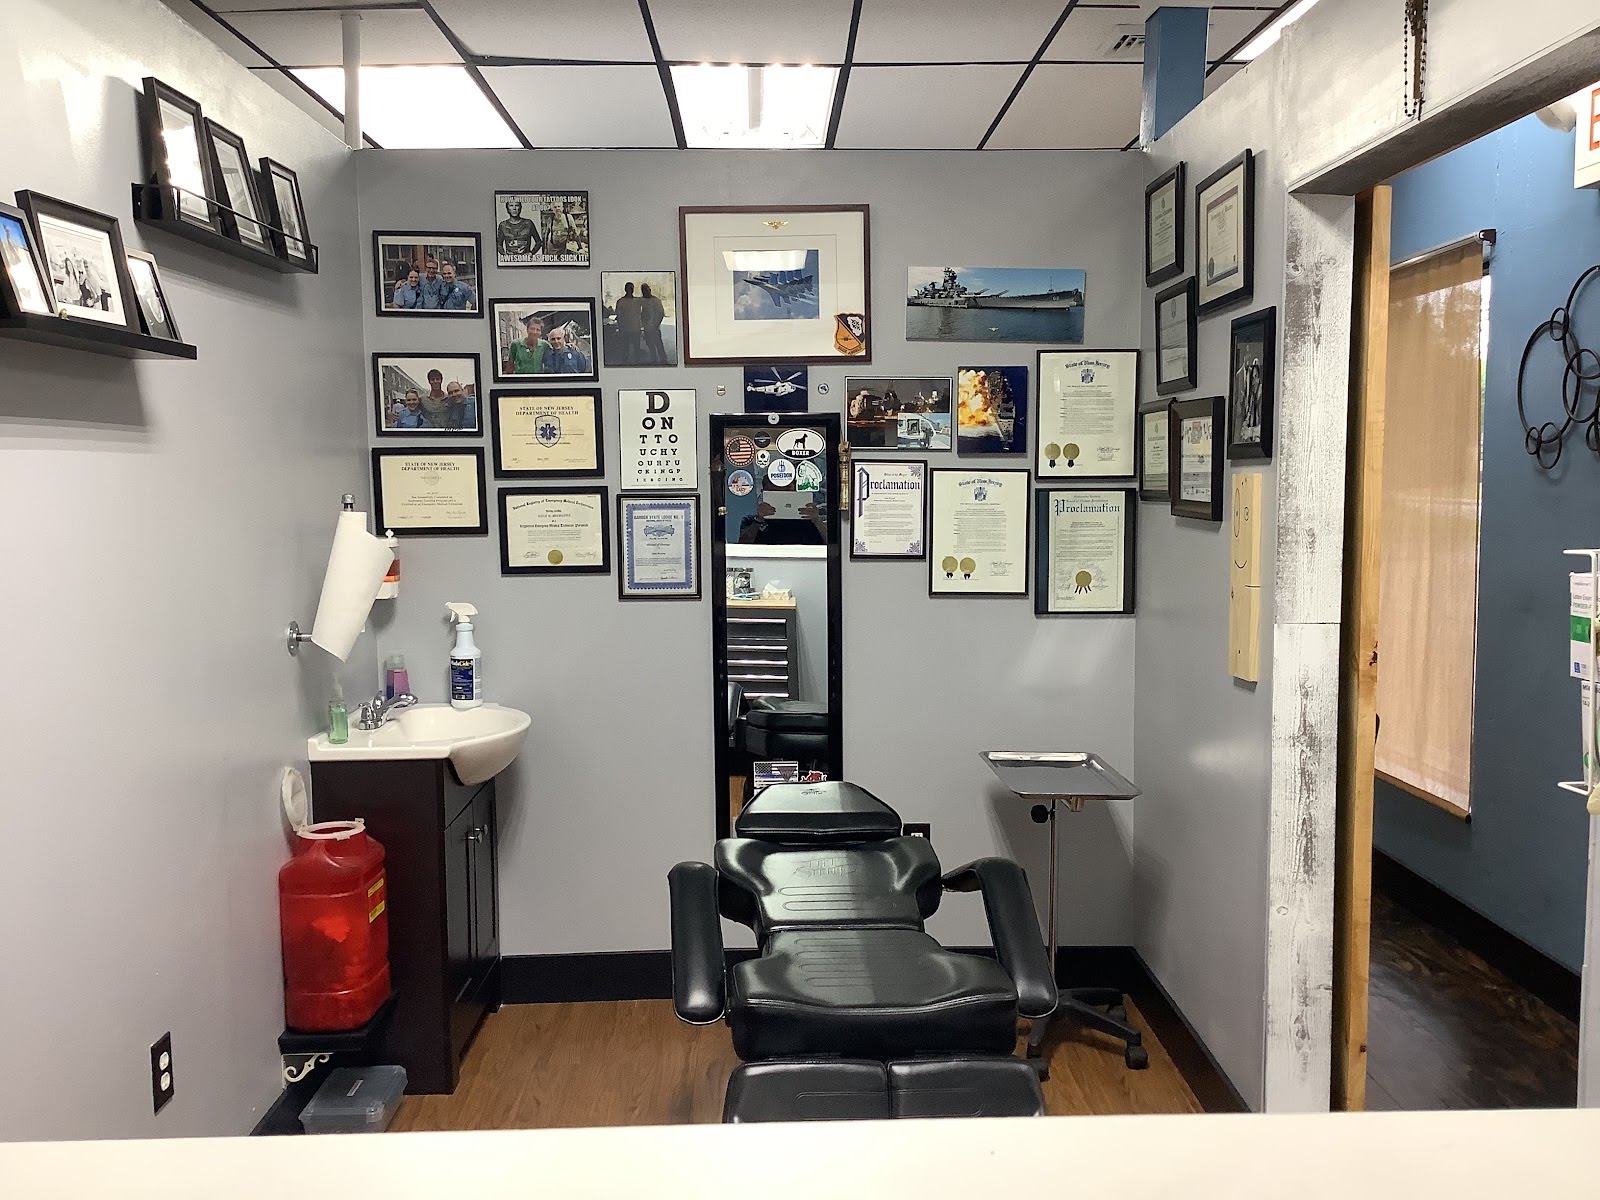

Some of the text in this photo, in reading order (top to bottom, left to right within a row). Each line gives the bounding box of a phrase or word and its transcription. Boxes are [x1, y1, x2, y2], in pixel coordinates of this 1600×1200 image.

[500, 254, 532, 262] AWESOME
[560, 254, 577, 262] SUCK
[646, 391, 670, 414] D
[642, 416, 674, 430] ON
[1054, 498, 1120, 516] Proclamation
